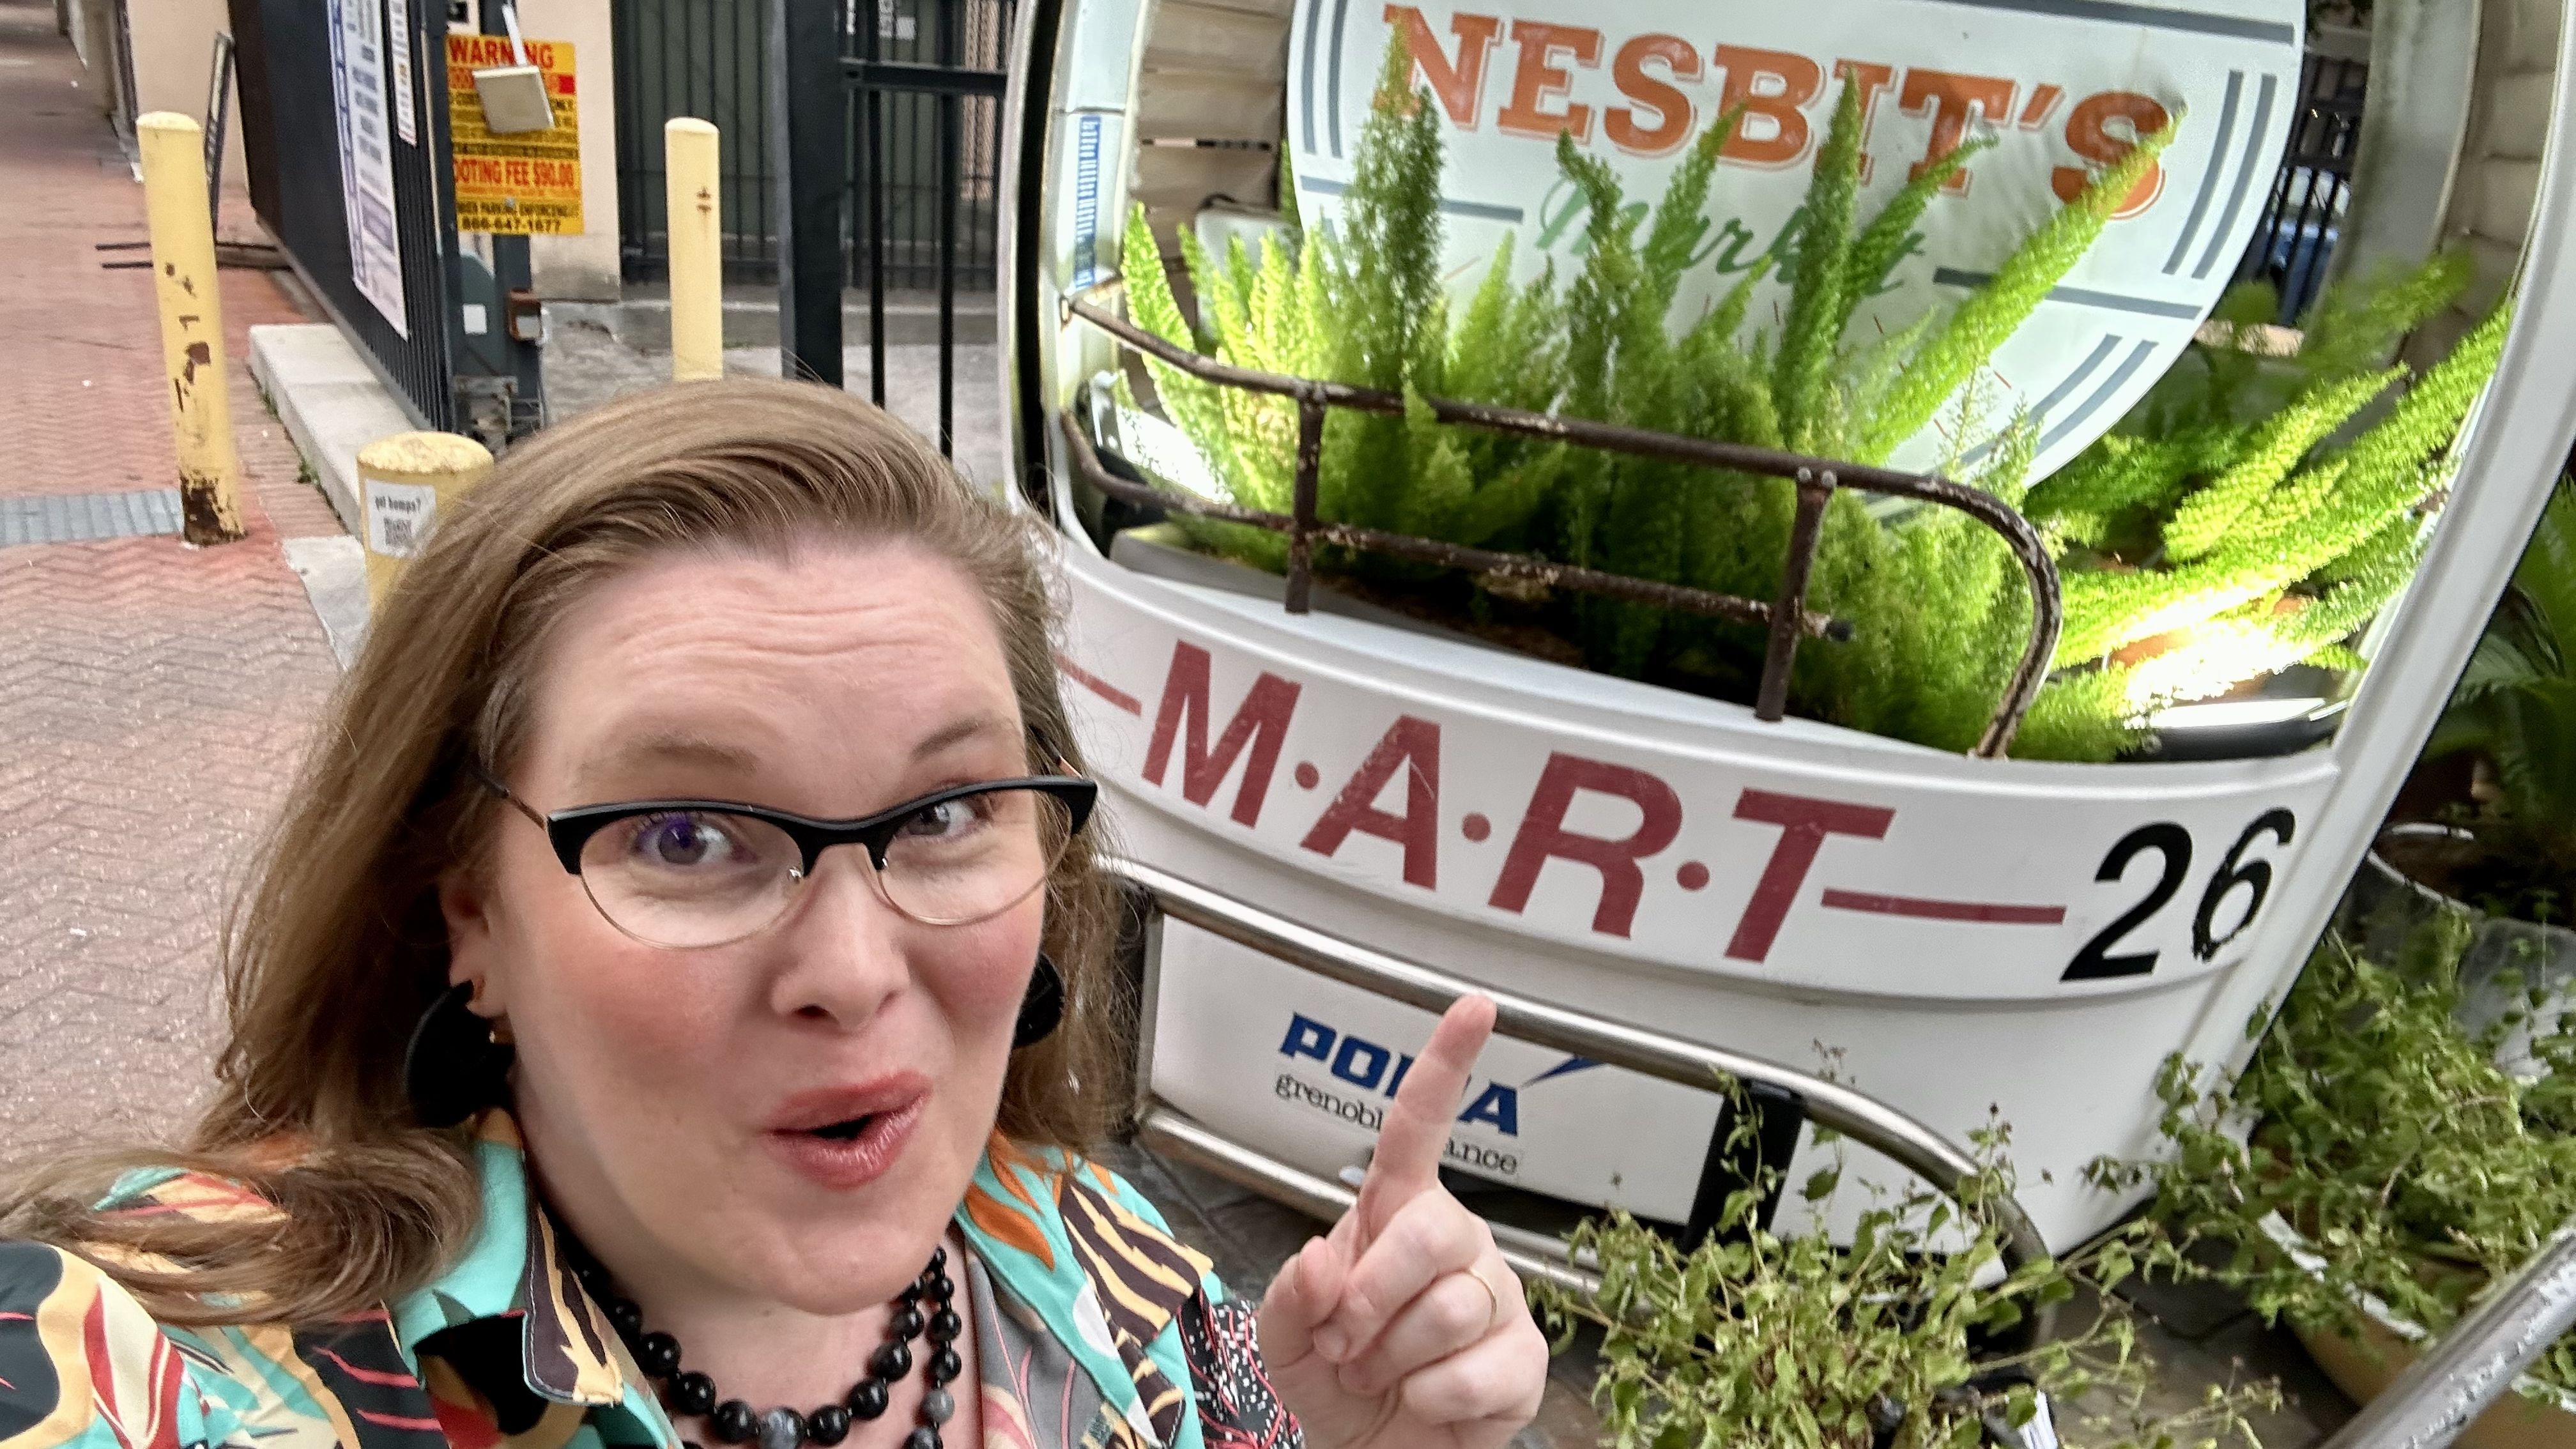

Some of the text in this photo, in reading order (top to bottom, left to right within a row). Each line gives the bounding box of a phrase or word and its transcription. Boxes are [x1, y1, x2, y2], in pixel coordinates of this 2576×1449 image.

[448, 37, 553, 69] WARNNG
[2060, 807, 2296, 983] 26
[1276, 1073, 1382, 1131] grenobl
